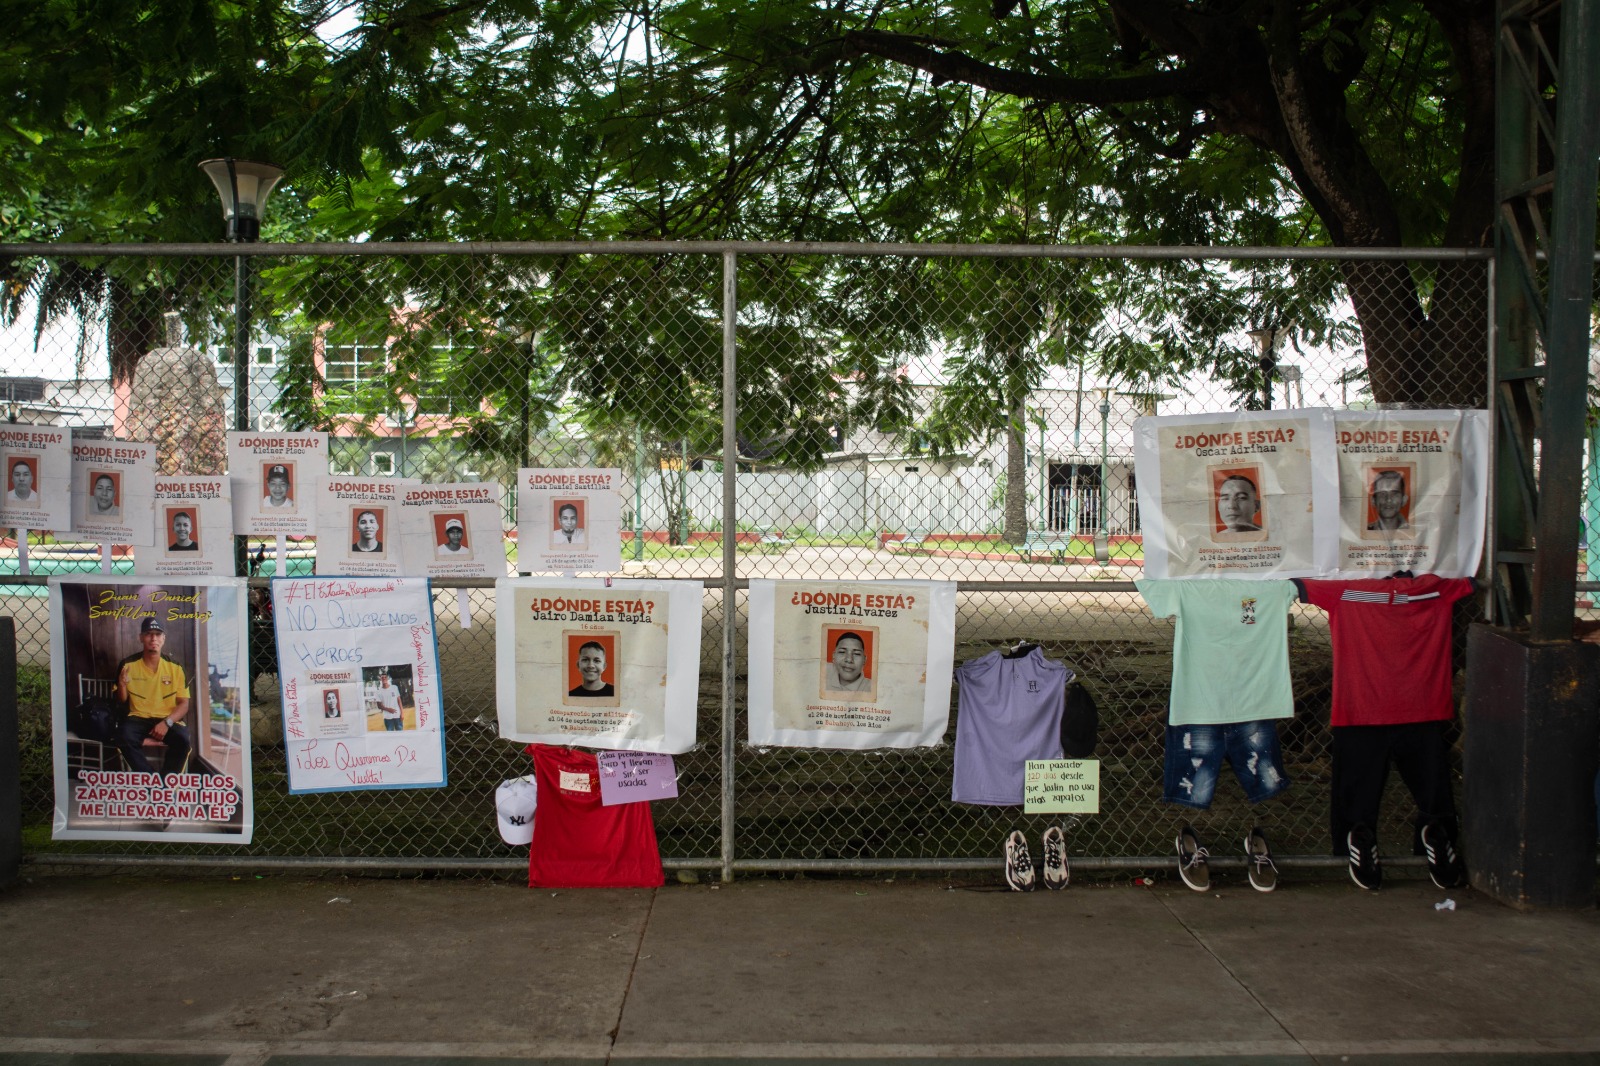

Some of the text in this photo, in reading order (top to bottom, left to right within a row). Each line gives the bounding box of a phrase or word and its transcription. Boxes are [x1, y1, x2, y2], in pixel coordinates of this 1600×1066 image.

[0, 430, 62, 443] ÓNDE ESTÁ?
[238, 437, 319, 448] ¿DÓNDE ESTÁ?
[1175, 427, 1295, 449] ¿DÓNDE ESTÁ?
[1402, 428, 1449, 444] ESTÁ?
[73, 445, 147, 459] DÓNDE ESTÁ?
[1195, 443, 1277, 457] Oscar Adrihan
[1342, 443, 1442, 453] Jonathan Adrihan
[529, 473, 611, 484] ¿DÓNDE ESTÁ?
[155, 481, 221, 492] ÓNDE ESTÁ?
[328, 480, 376, 493] ¿DÓNDE
[406, 488, 489, 500] ¿DÓNDE ESTÁ?
[100, 590, 202, 604] Juan Daniel
[791, 590, 915, 609] ¿DÓNDE ESTÁ?
[531, 596, 655, 614] ¿DÓNDE ESTÁ?
[850, 605, 898, 618] Alvarez
[286, 605, 317, 631] NO
[533, 610, 652, 624] Jairo Damian Tapia
[1028, 761, 1045, 771] Han
[167, 774, 200, 788] QUE
[205, 776, 234, 788] LOS
[618, 778, 647, 788] usadas
[1026, 785, 1039, 793] que
[77, 788, 238, 806] ZAPATOS DE MI HIJO
[80, 804, 103, 816] ME
[109, 805, 188, 818] LLEVARAN
[195, 806, 205, 818] A
